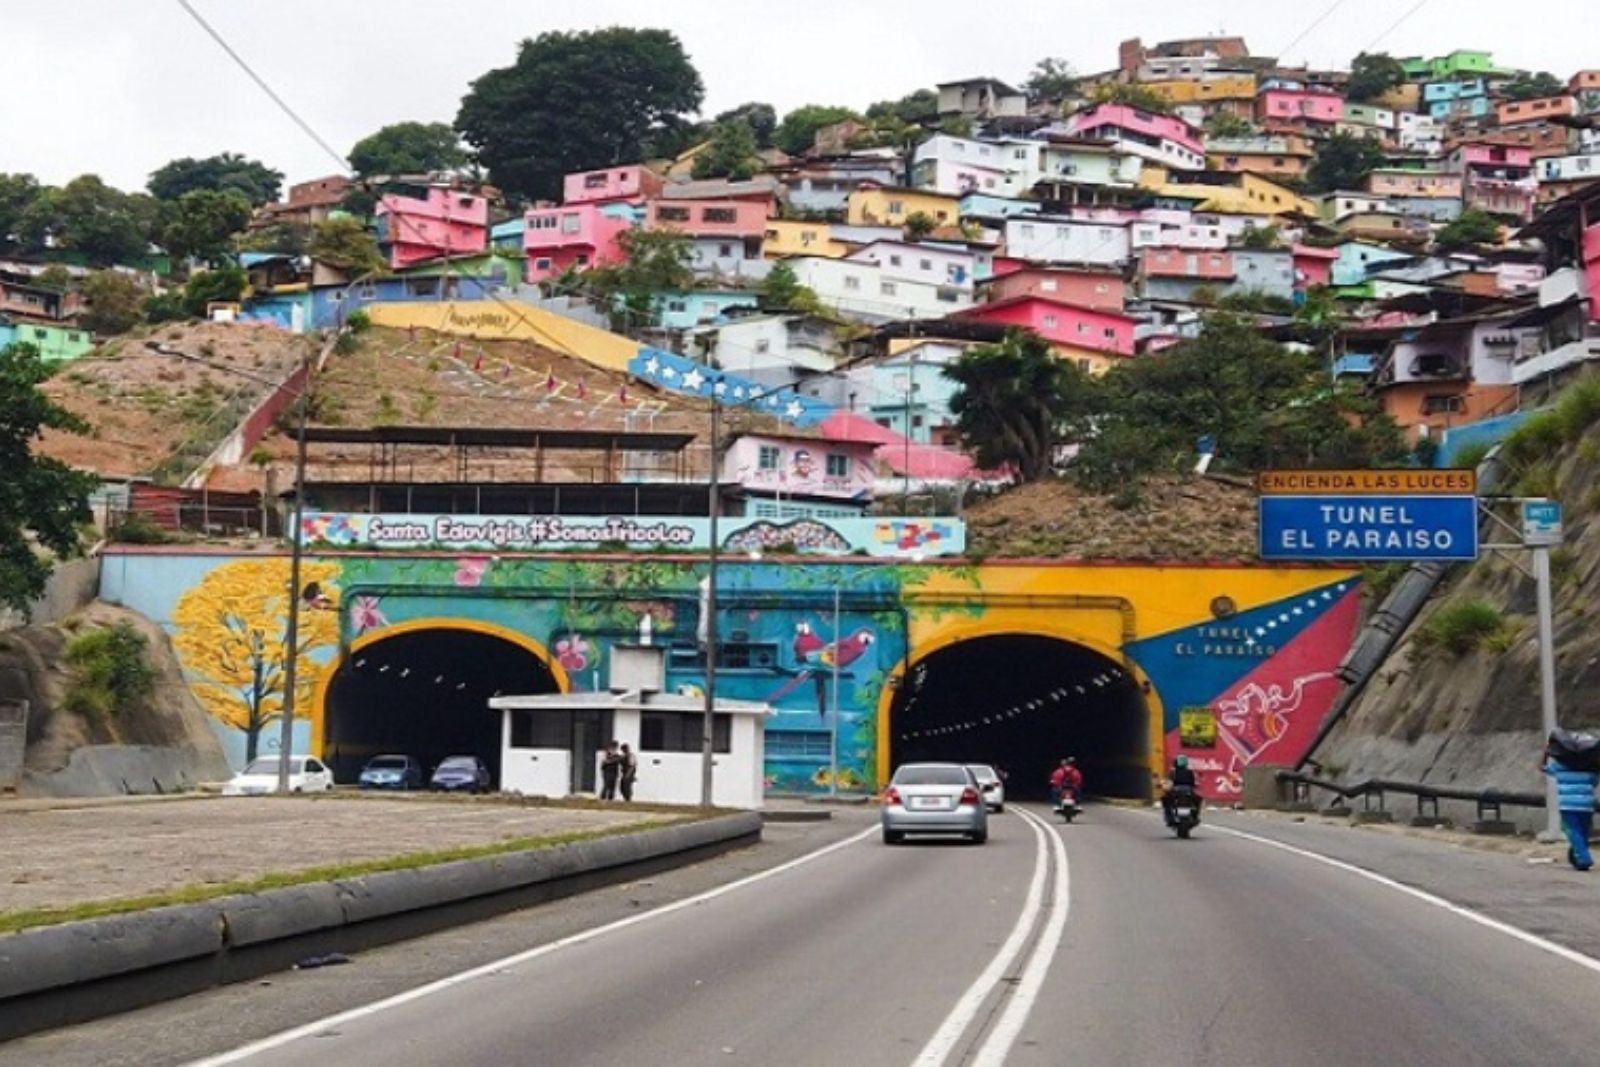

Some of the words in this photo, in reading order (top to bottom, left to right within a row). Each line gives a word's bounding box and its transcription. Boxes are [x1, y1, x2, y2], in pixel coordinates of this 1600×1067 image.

[1262, 474, 1356, 489] ENCIENDA
[1363, 474, 1399, 489] LAS
[1407, 474, 1470, 489] LUCES
[1320, 505, 1414, 524] TUNEL
[369, 516, 428, 540] Santa
[1281, 529, 1315, 549] EL
[1326, 529, 1453, 549] PARAISO
[1197, 626, 1250, 638] TUNEL
[1176, 643, 1195, 655] EL
[1204, 644, 1276, 656] PARAISO
